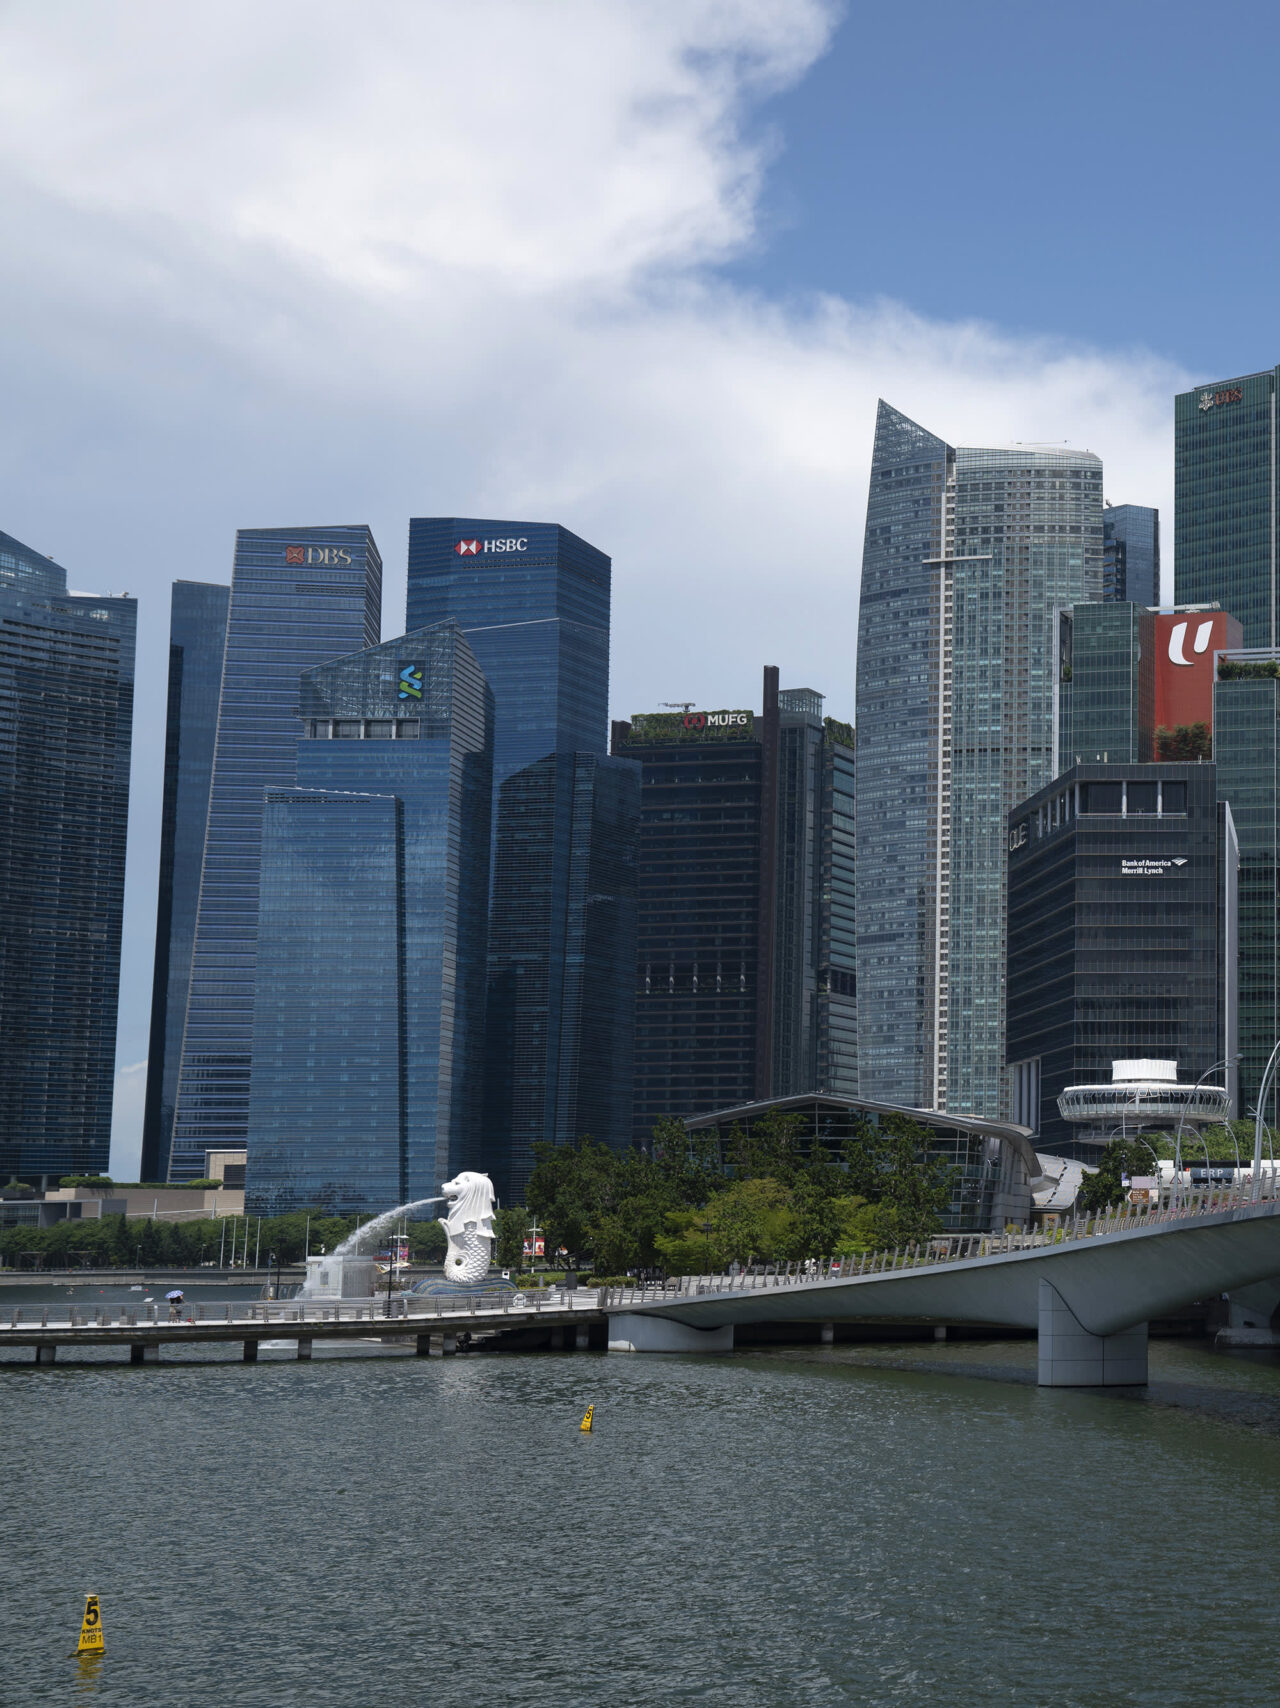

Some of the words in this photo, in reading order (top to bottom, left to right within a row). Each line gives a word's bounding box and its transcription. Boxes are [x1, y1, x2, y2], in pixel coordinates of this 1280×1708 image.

[484, 538, 528, 553] HSBC
[307, 546, 352, 565] DBS
[707, 713, 747, 726] MUFG
[1145, 859, 1172, 867] America
[1144, 867, 1163, 875] Lynch
[1200, 1168, 1224, 1177] ERP
[86, 1600, 98, 1626] 5
